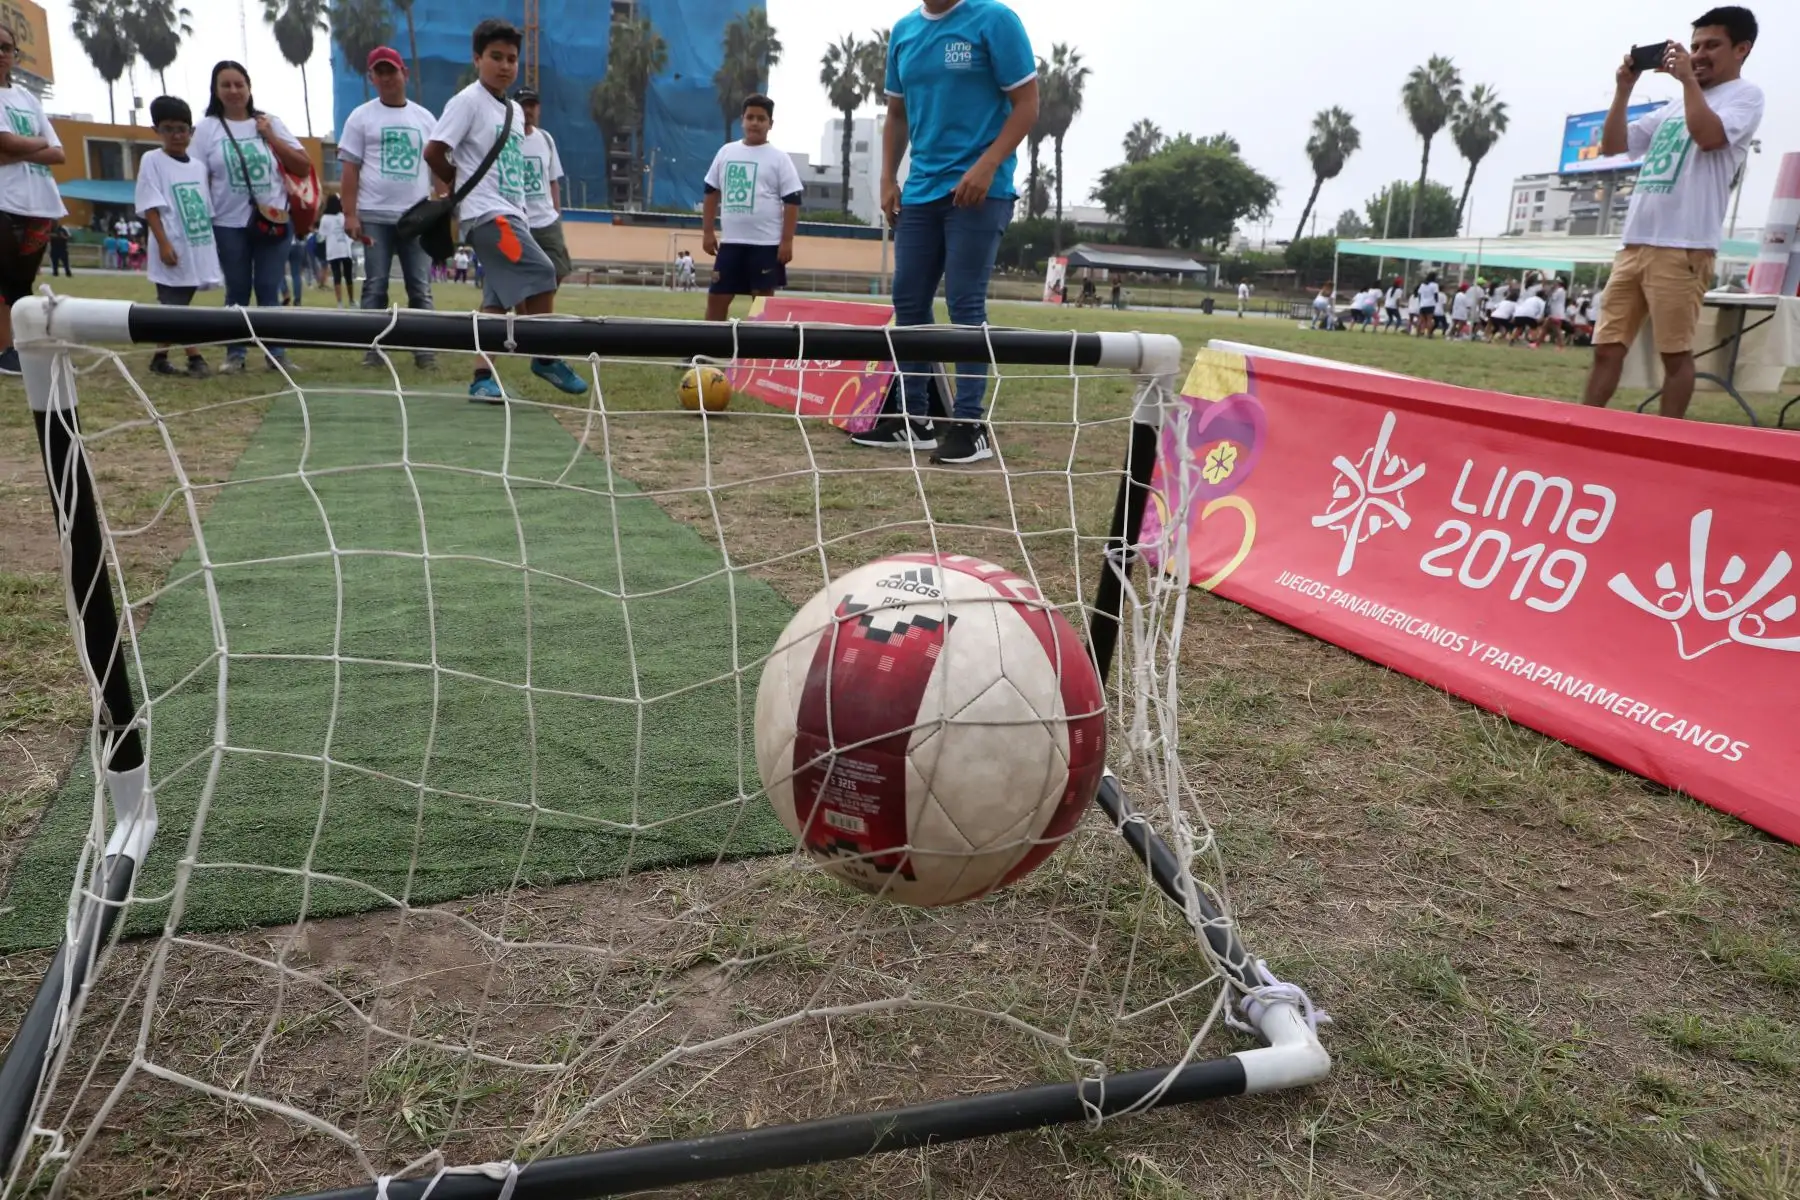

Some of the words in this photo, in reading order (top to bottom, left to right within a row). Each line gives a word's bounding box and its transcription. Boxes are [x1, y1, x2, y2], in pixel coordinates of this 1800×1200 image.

[944, 51, 972, 62] 2019
[386, 157, 414, 170] CO
[234, 166, 265, 181] CO
[729, 165, 747, 179] BA
[727, 189, 747, 202] CO
[1420, 520, 1587, 612] 2019
[876, 579, 941, 598] adidas
[1275, 570, 1330, 600] JUEGOS
[1327, 588, 1469, 652] PANAMERICANOS
[1468, 640, 1483, 657] Y
[1480, 646, 1750, 762] PARAPANAMERICANOS
[838, 777, 856, 790] SIZE
